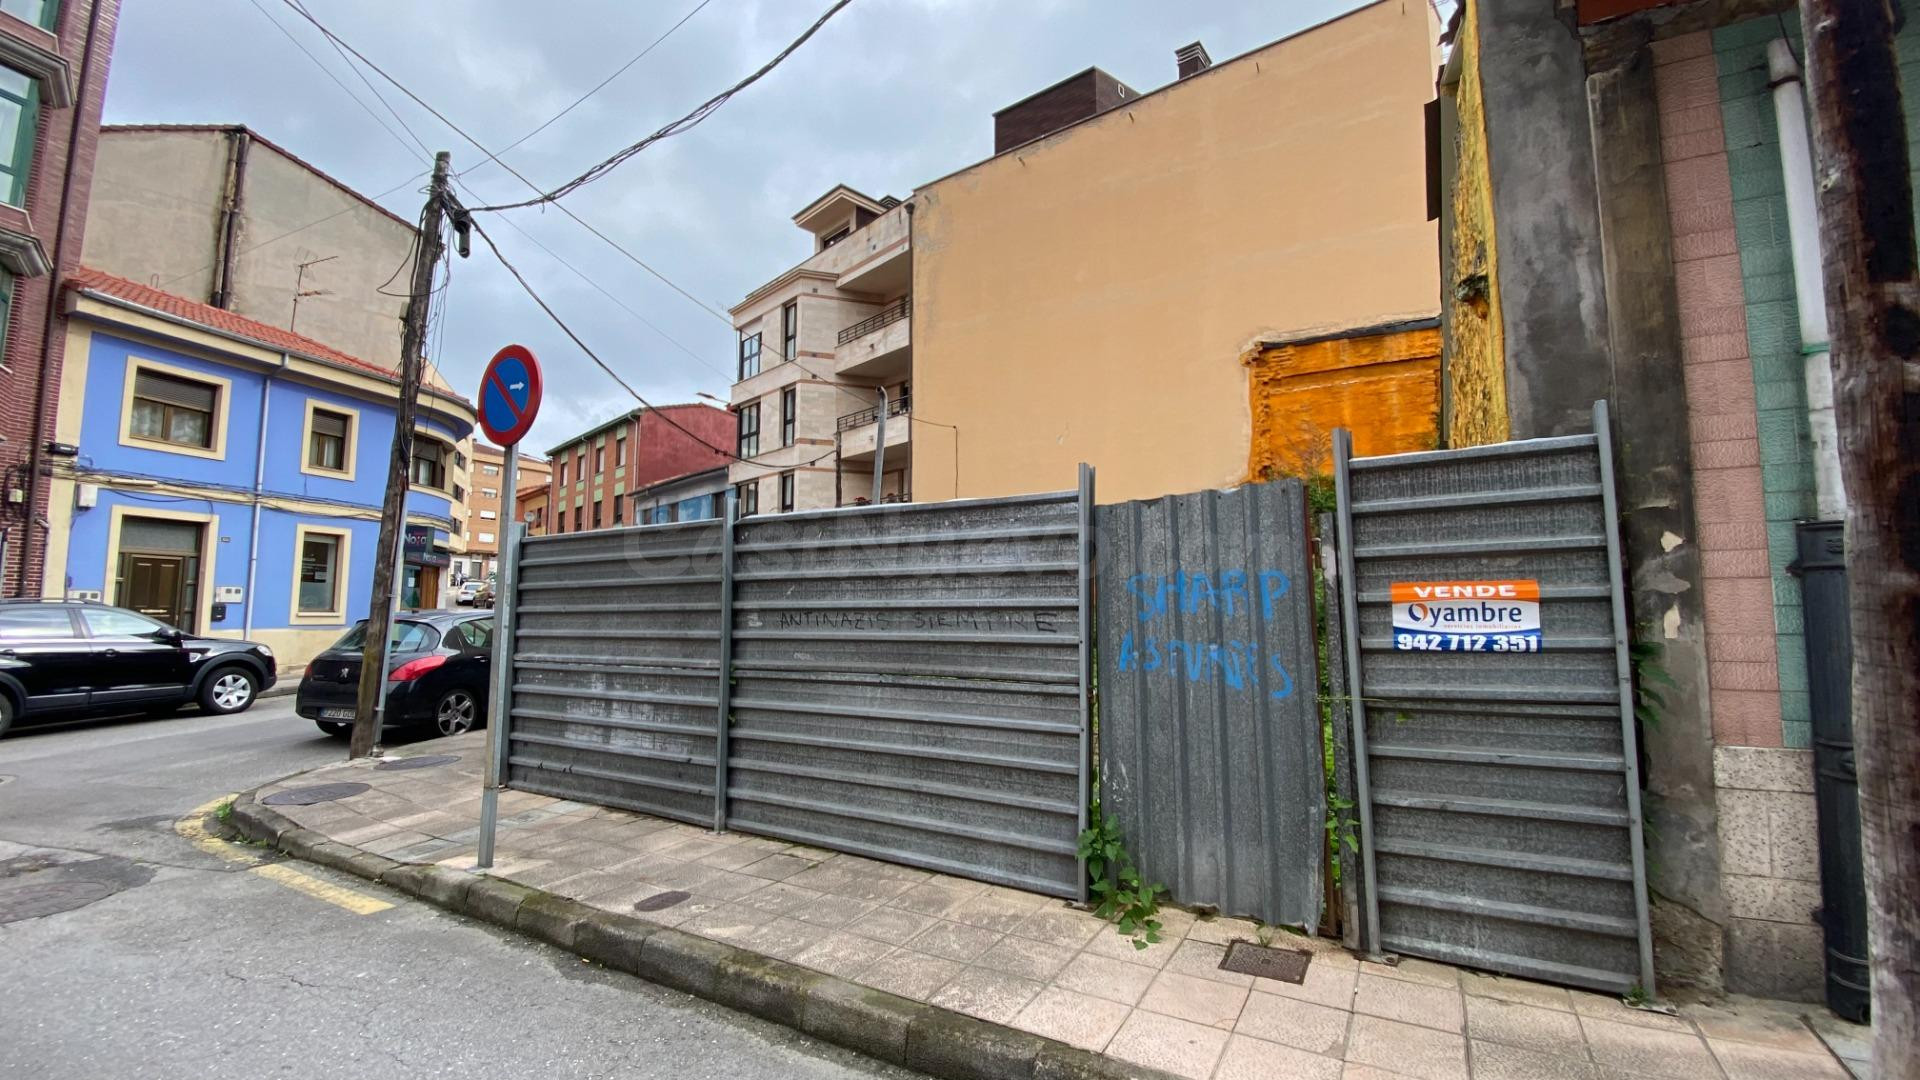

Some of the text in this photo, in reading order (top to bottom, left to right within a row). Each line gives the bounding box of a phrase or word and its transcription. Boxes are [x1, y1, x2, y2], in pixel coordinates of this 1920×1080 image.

[1126, 567, 1290, 622] SHARP
[1414, 584, 1517, 598] VENDE
[778, 611, 890, 632] ANTINAZIS
[1408, 601, 1522, 628] Oyambre
[1397, 633, 1537, 653] 942 712 351
